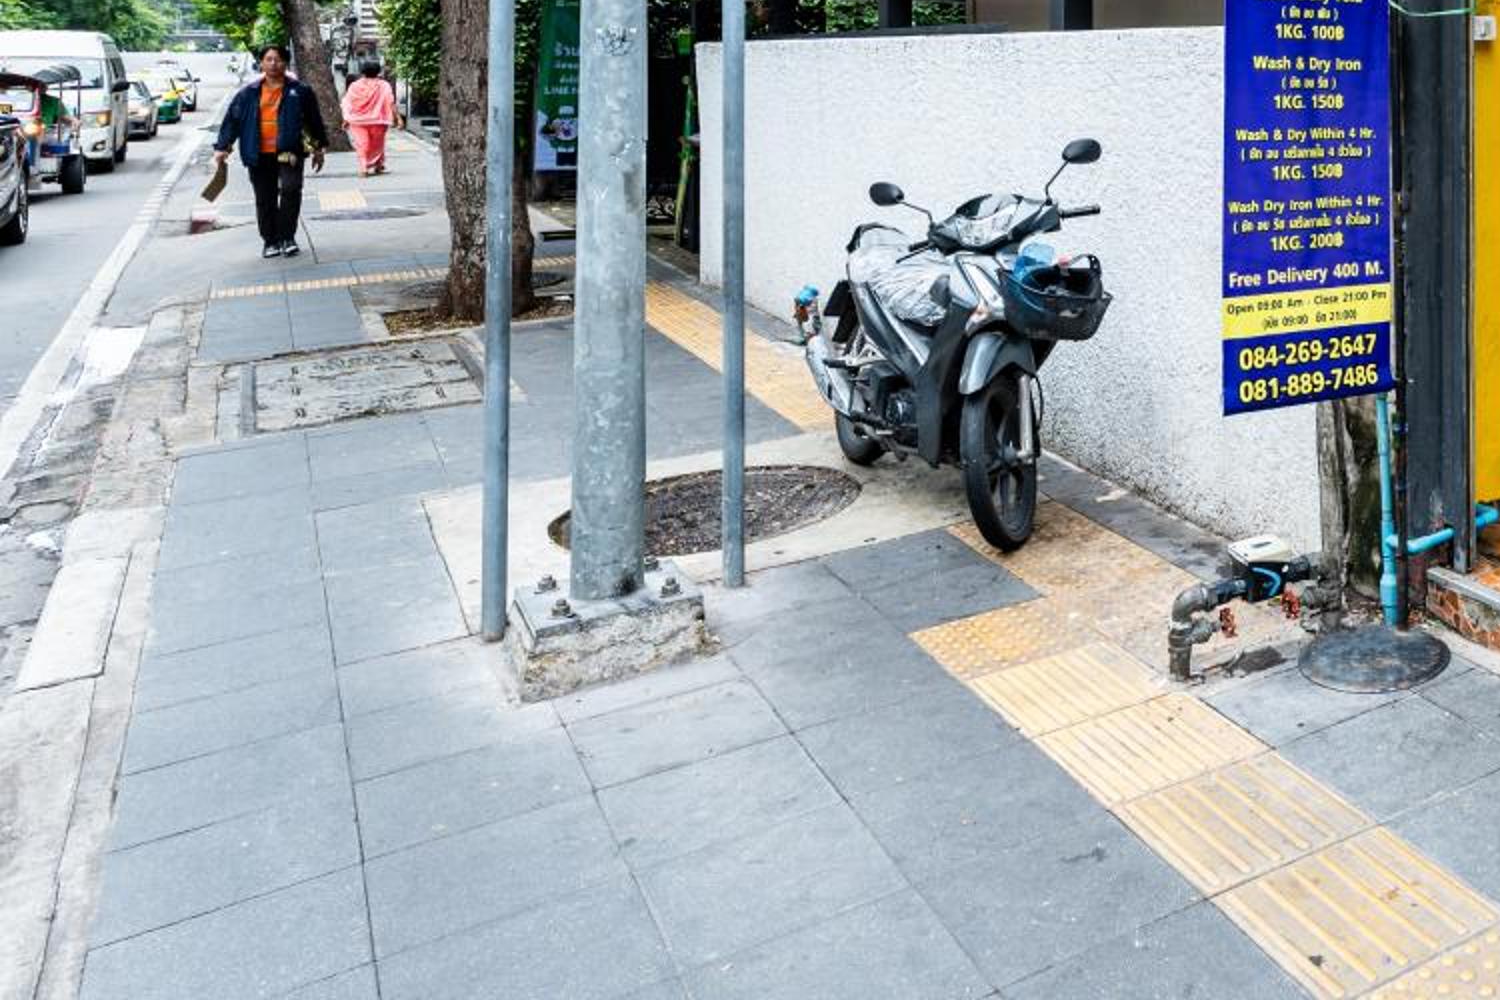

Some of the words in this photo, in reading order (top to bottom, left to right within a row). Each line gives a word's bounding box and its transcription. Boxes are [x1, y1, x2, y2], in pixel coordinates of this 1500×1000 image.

[1275, 24, 1306, 39] 1KG.
[1253, 56, 1291, 70] Wash
[1296, 56, 1305, 70] &
[1309, 57, 1331, 74] Dry
[1335, 57, 1361, 70] Iron
[1274, 94, 1306, 109] 1KG.
[1235, 128, 1268, 141] Wash
[1287, 129, 1306, 143] Dry
[1310, 128, 1345, 139] Within
[1348, 128, 1356, 139] 4
[1272, 165, 1306, 180] 1KG.
[1228, 200, 1259, 214] Wash
[1264, 200, 1285, 215] Dry
[1290, 200, 1312, 211] Iron
[1316, 195, 1352, 209] Within
[1355, 195, 1363, 206] 4
[1270, 236, 1304, 251] 1KG.
[1229, 272, 1262, 288] Free
[1267, 267, 1328, 285] Delivery
[1332, 263, 1359, 279] 400
[1227, 303, 1254, 315] Open
[1314, 294, 1338, 306] Close
[1342, 291, 1369, 303] 21:00
[1371, 290, 1387, 300] Pm
[1239, 333, 1377, 370] 084-269-2647
[1239, 364, 1379, 403] 081-889-7486
